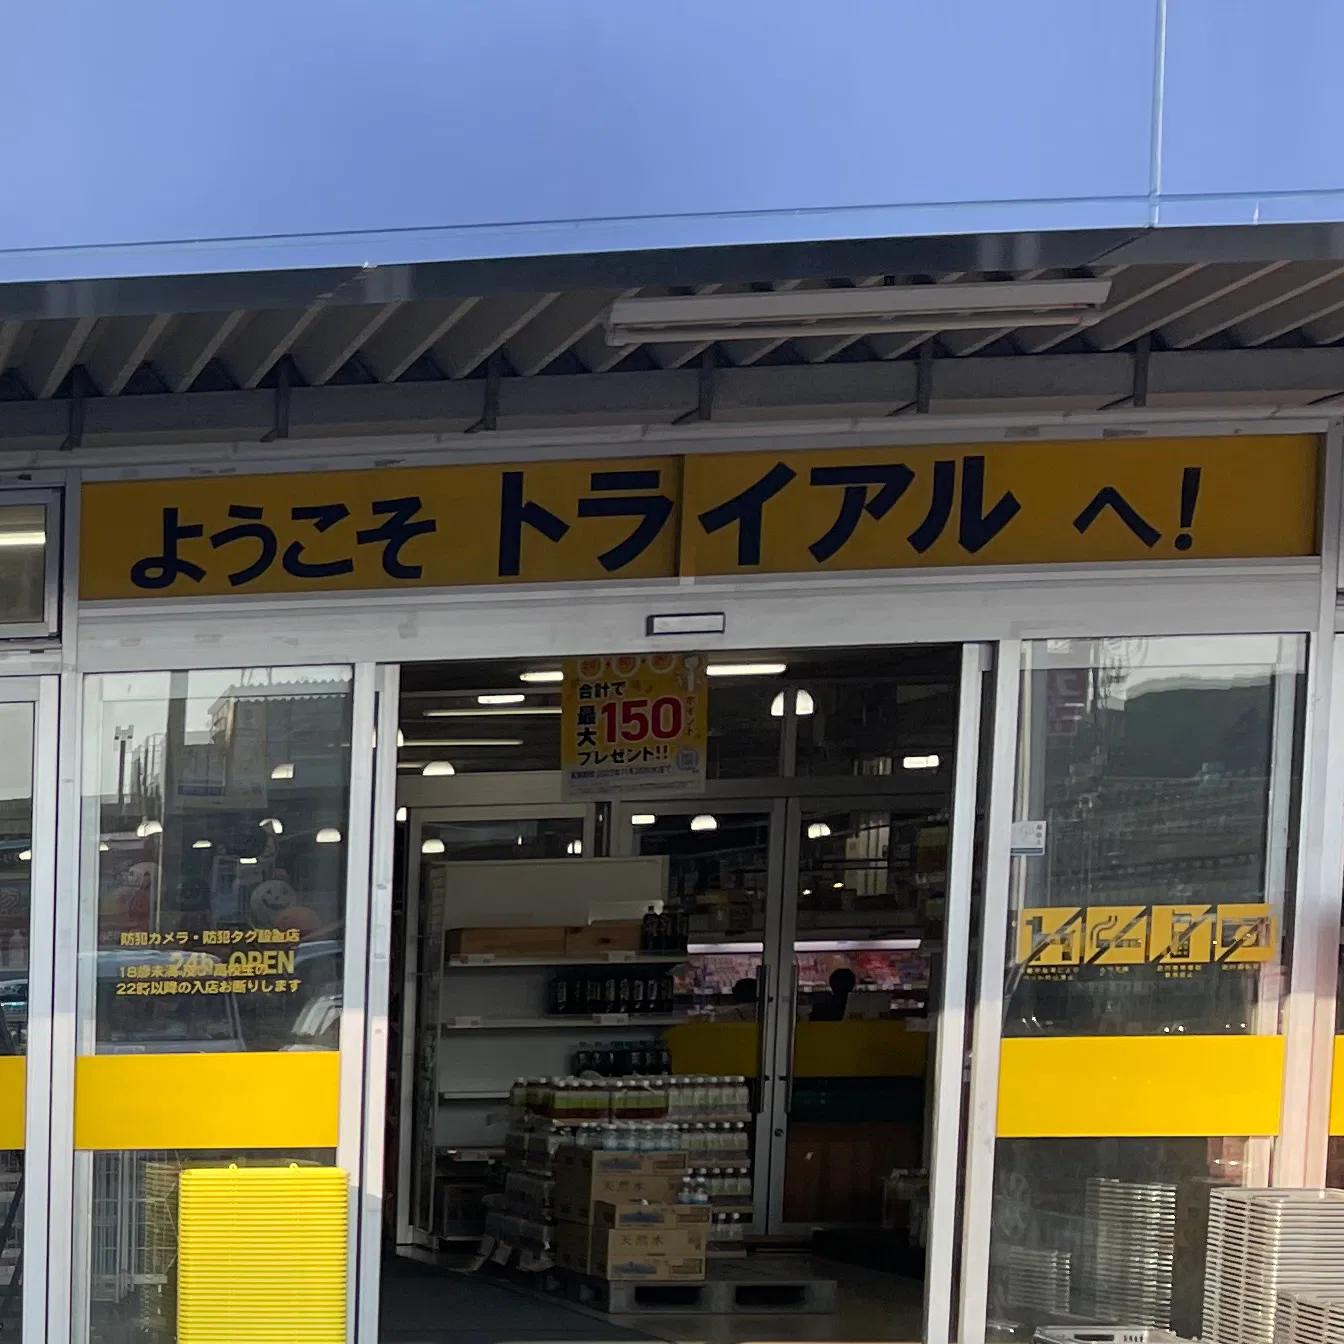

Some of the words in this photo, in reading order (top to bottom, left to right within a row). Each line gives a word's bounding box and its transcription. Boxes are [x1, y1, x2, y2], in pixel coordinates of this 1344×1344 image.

[130, 495, 437, 589] ようこそ
[498, 456, 1021, 577] トライアル
[579, 681, 626, 699] 合計で
[601, 697, 682, 743] 150
[229, 950, 295, 975] OPEN
